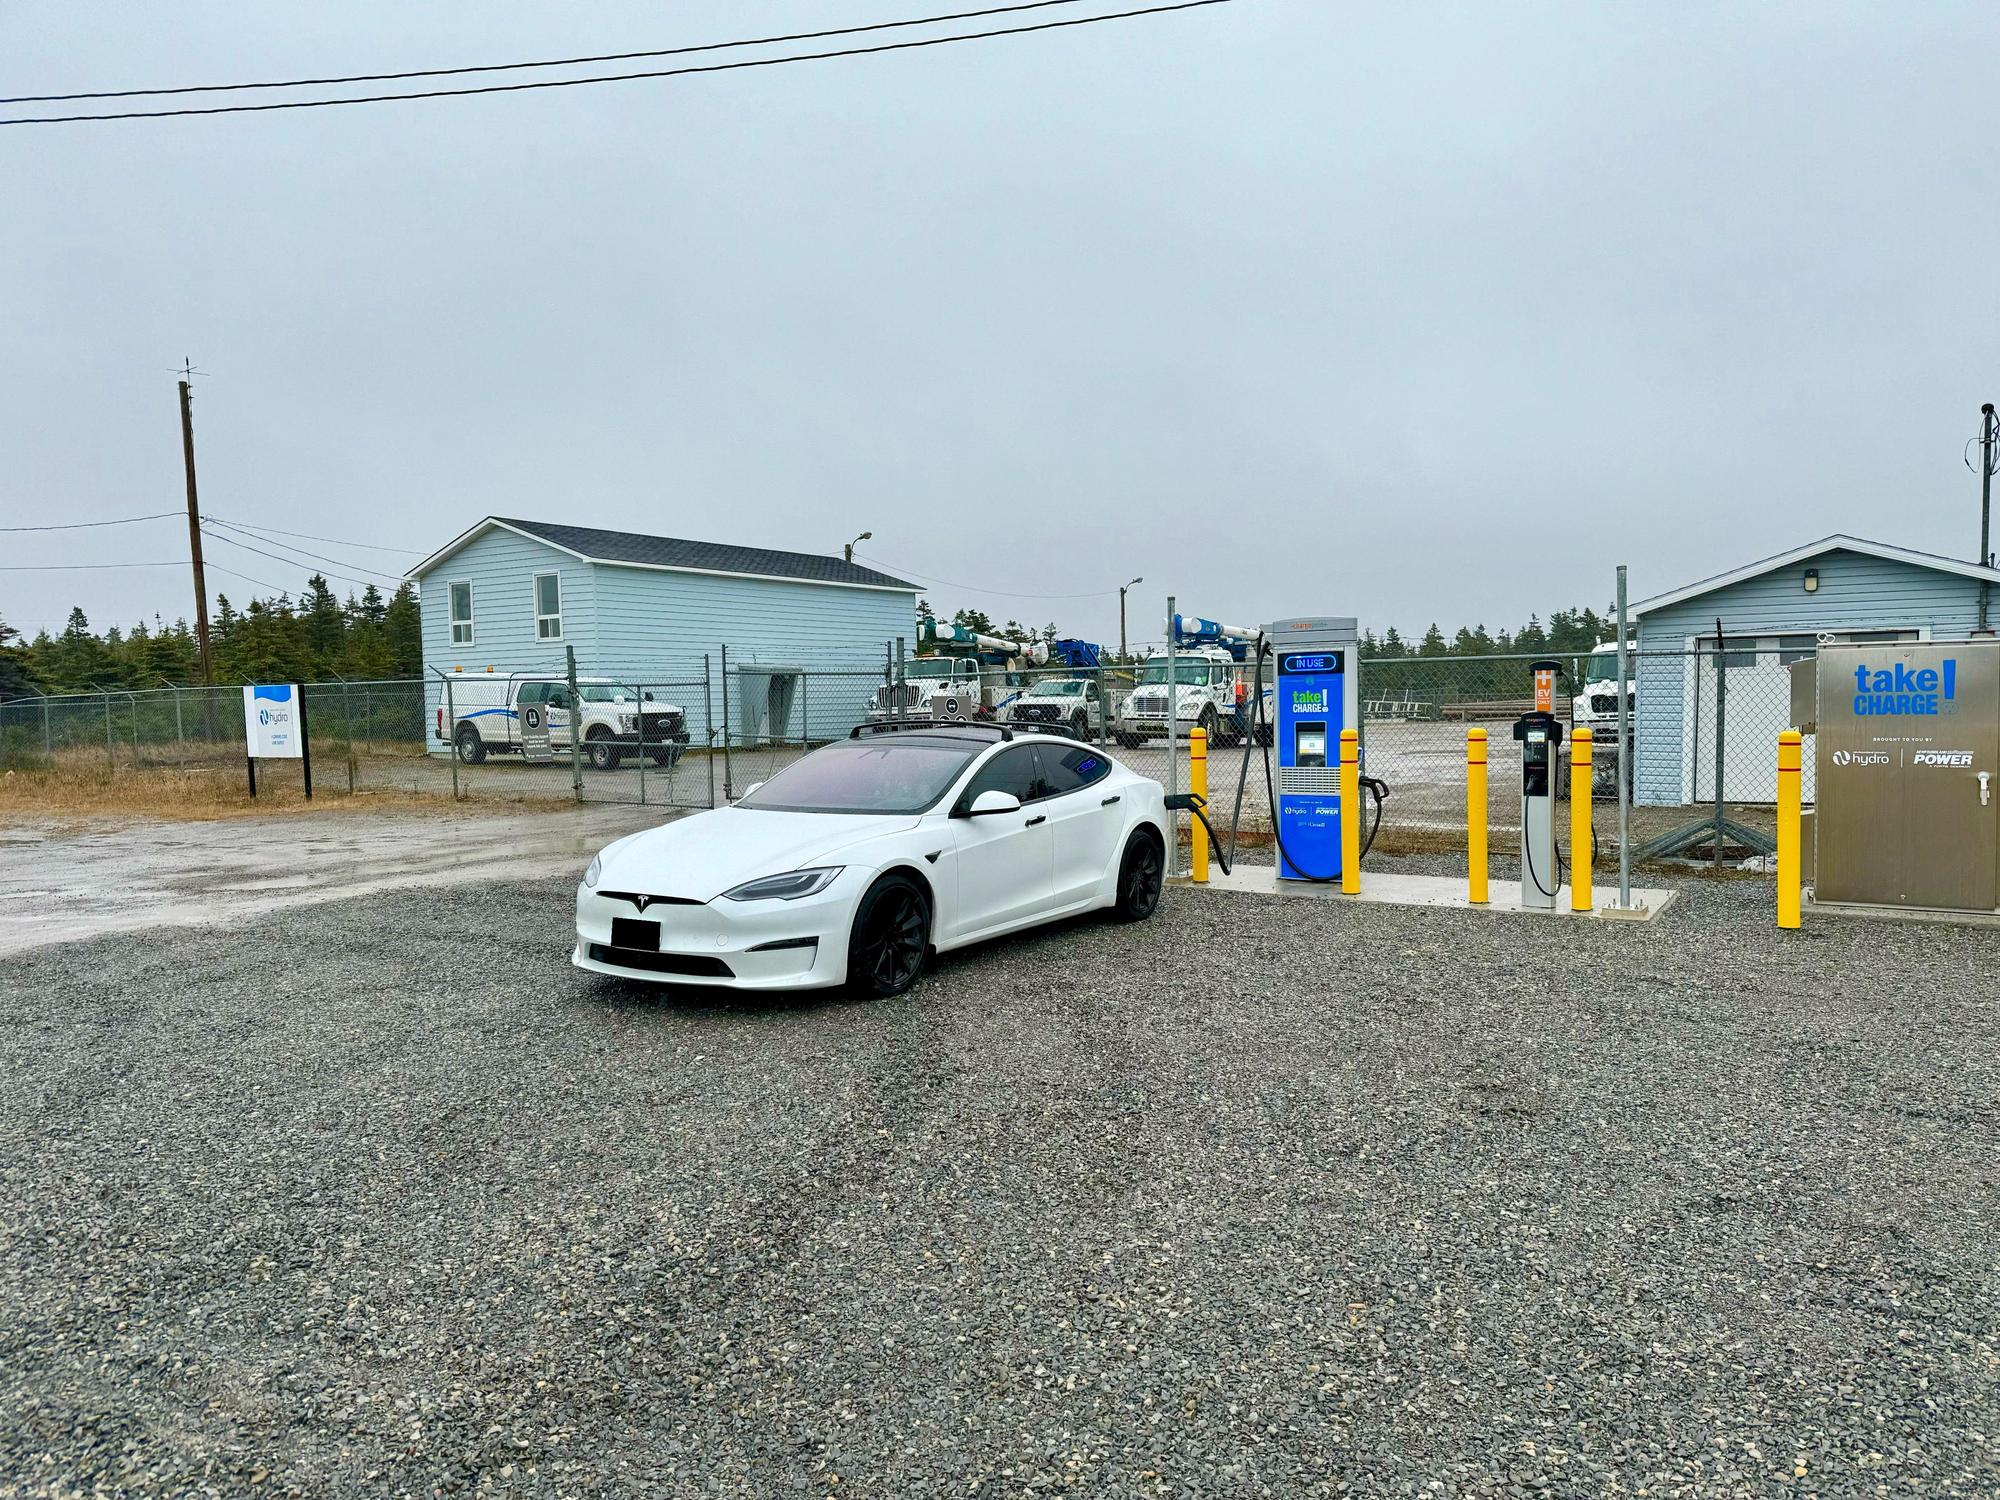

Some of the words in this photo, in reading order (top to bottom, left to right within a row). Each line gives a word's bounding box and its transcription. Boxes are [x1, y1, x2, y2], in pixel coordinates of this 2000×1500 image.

[1296, 659, 1305, 668] IN
[1307, 658, 1324, 668] USE
[269, 712, 288, 724] hydro
[1852, 753, 1889, 766] hydro
[1913, 754, 1972, 764] POWER
